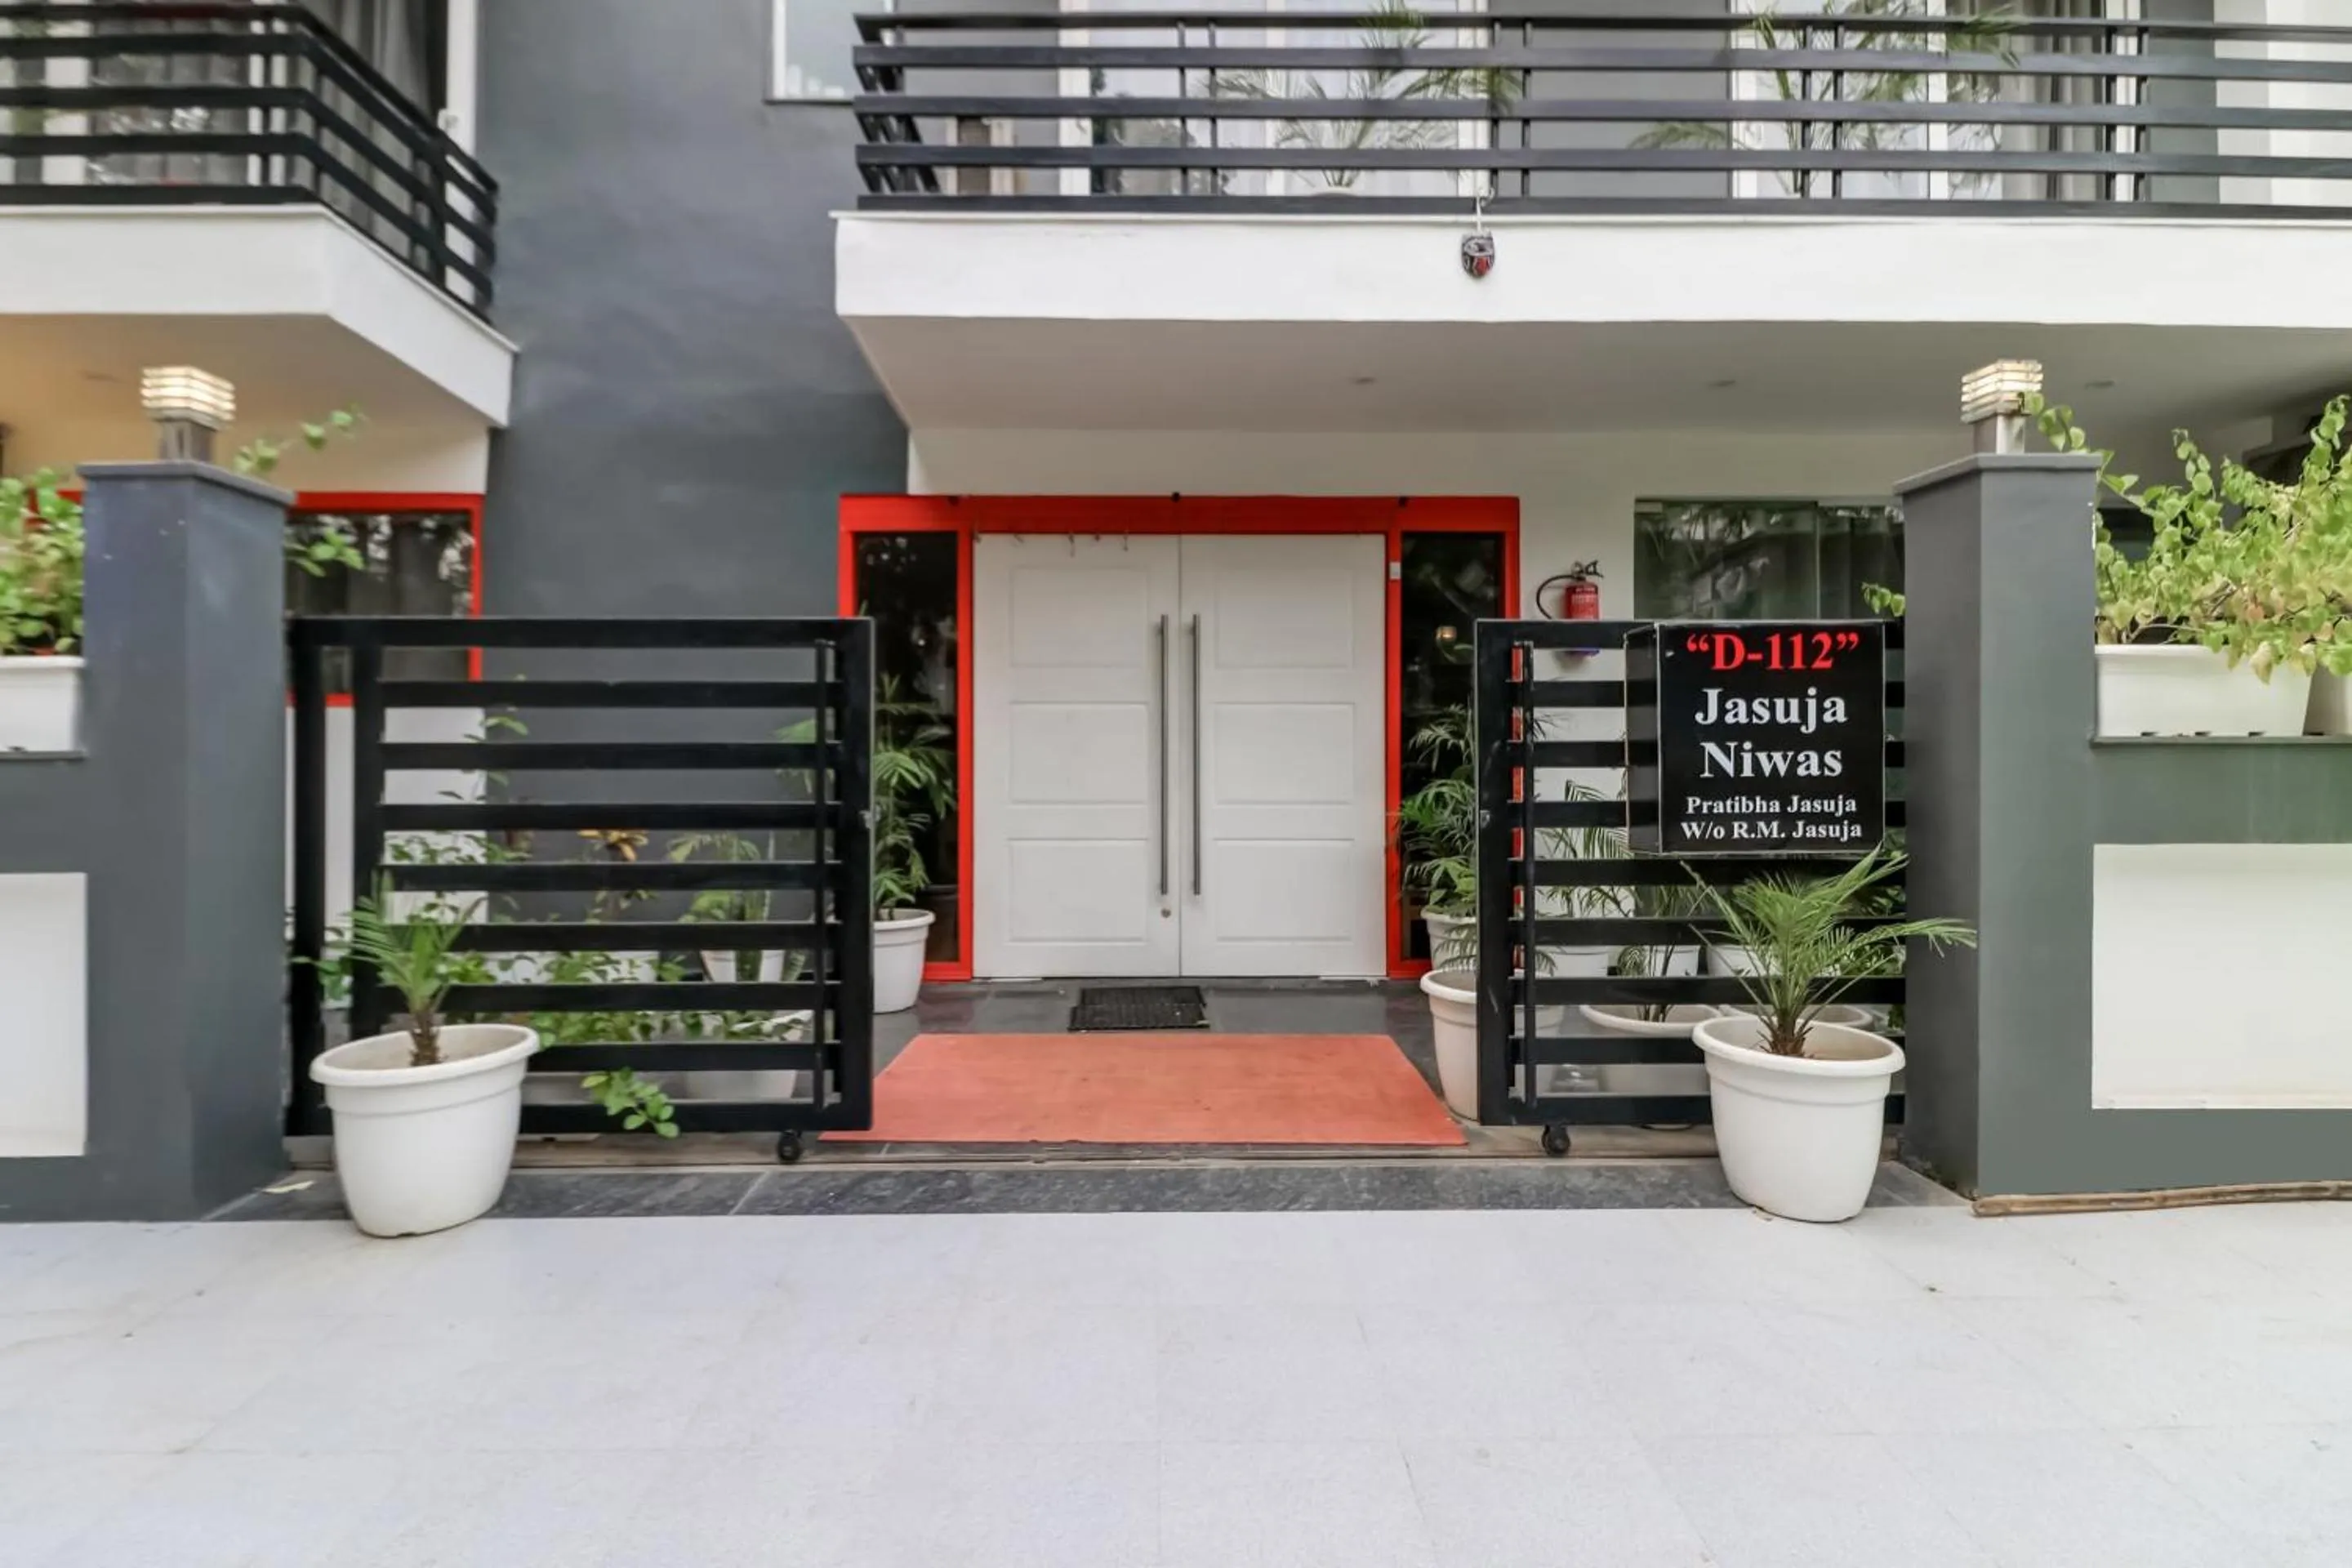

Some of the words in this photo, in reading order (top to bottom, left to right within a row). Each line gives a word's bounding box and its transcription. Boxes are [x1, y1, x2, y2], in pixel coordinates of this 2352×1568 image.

[1695, 686, 1847, 734] Jasuja
[1699, 742, 1842, 777] Niwas
[1686, 795, 1780, 814] Pratibha
[1787, 795, 1857, 817] Jasuja
[1681, 822, 1725, 840] W/o
[1731, 821, 1786, 839] R.M.
[1792, 820, 1862, 842] Jasuja
